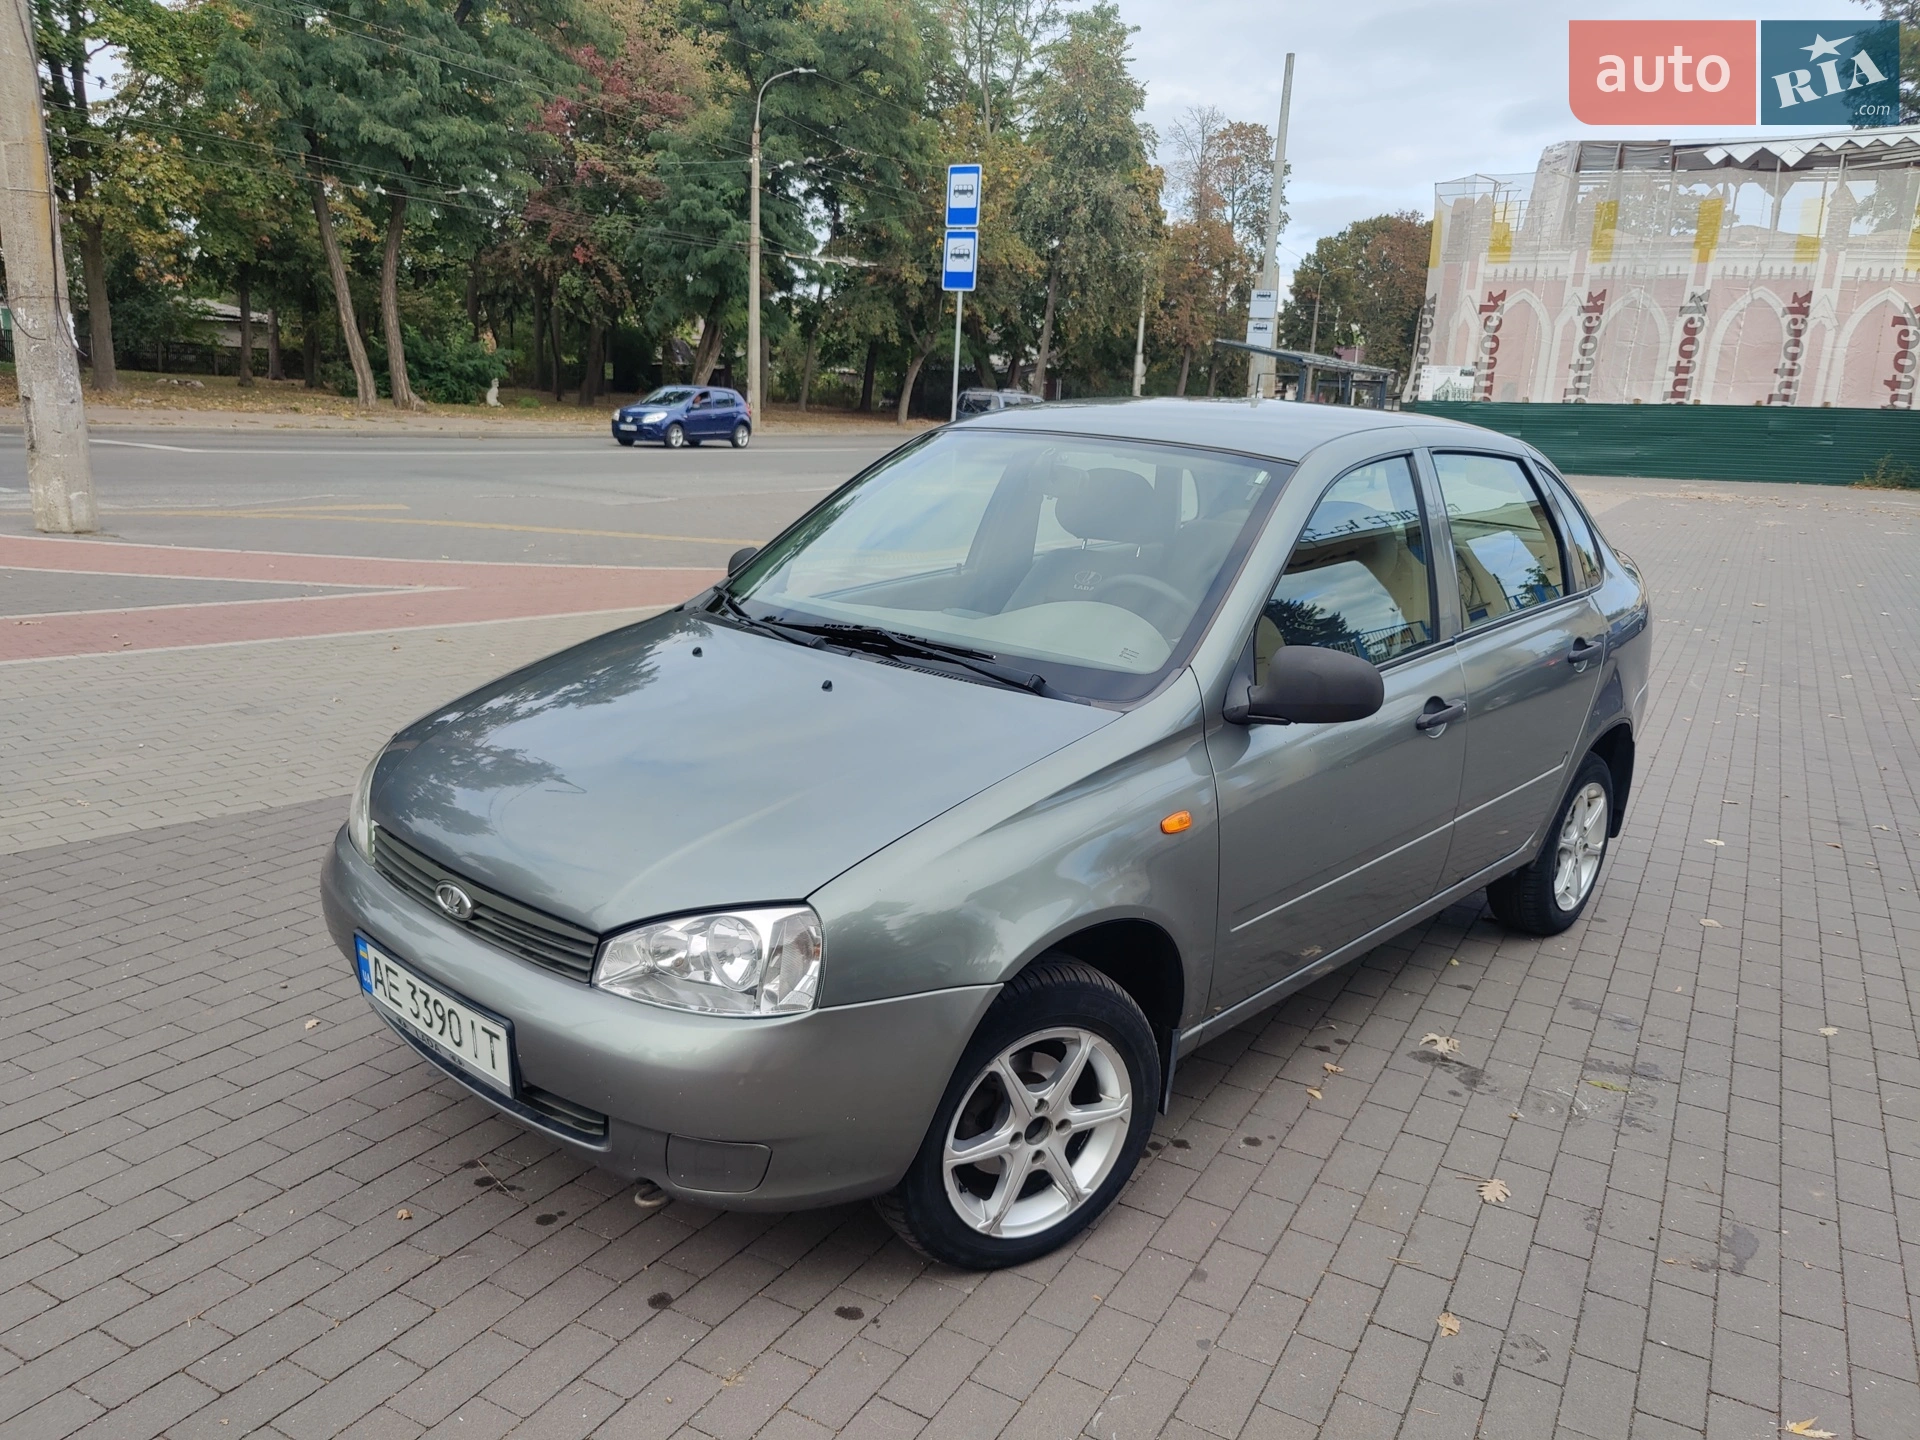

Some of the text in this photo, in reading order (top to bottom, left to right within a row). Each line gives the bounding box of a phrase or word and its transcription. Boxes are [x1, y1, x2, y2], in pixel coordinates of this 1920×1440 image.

[1662, 290, 1711, 404] htock
[362, 970, 372, 985] UA
[374, 956, 501, 1070] AE 3390 IT
[415, 1029, 443, 1054] LADA
